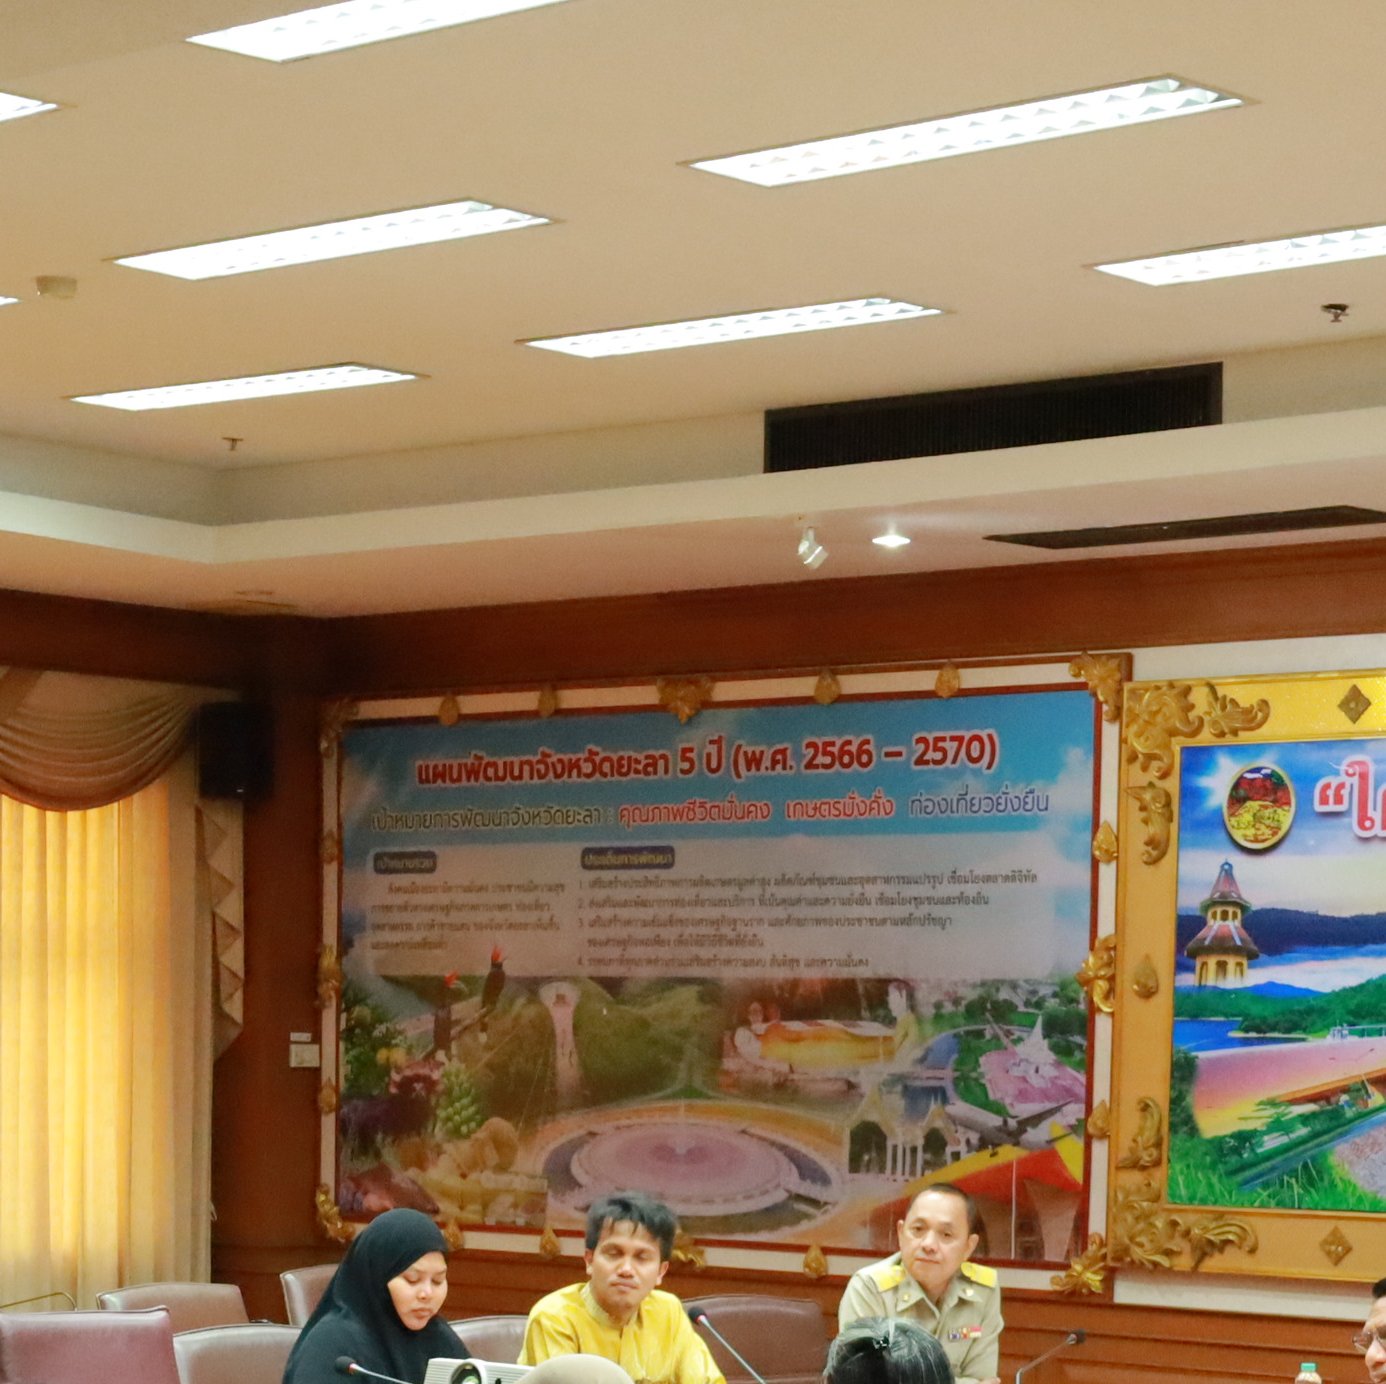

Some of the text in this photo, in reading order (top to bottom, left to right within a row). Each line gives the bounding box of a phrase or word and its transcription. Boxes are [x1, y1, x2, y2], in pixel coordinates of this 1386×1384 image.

[416, 745, 670, 785] แผนพัฒนาจังหวัดยะลา
[679, 747, 696, 776] 5
[704, 735, 725, 776] ปี
[732, 743, 794, 779] (พ.ศ.
[803, 738, 874, 770] 2566
[913, 733, 999, 771] 2570)
[371, 804, 602, 831] เป้าหมายการพัฒนาจังหวัดยะลา
[618, 793, 772, 831] คุณภาพชีวิตมั่นคง
[784, 788, 896, 820] เกษตรมั่งคั่ง
[909, 783, 1050, 817] ท่องเที่ยวยั่งยืน
